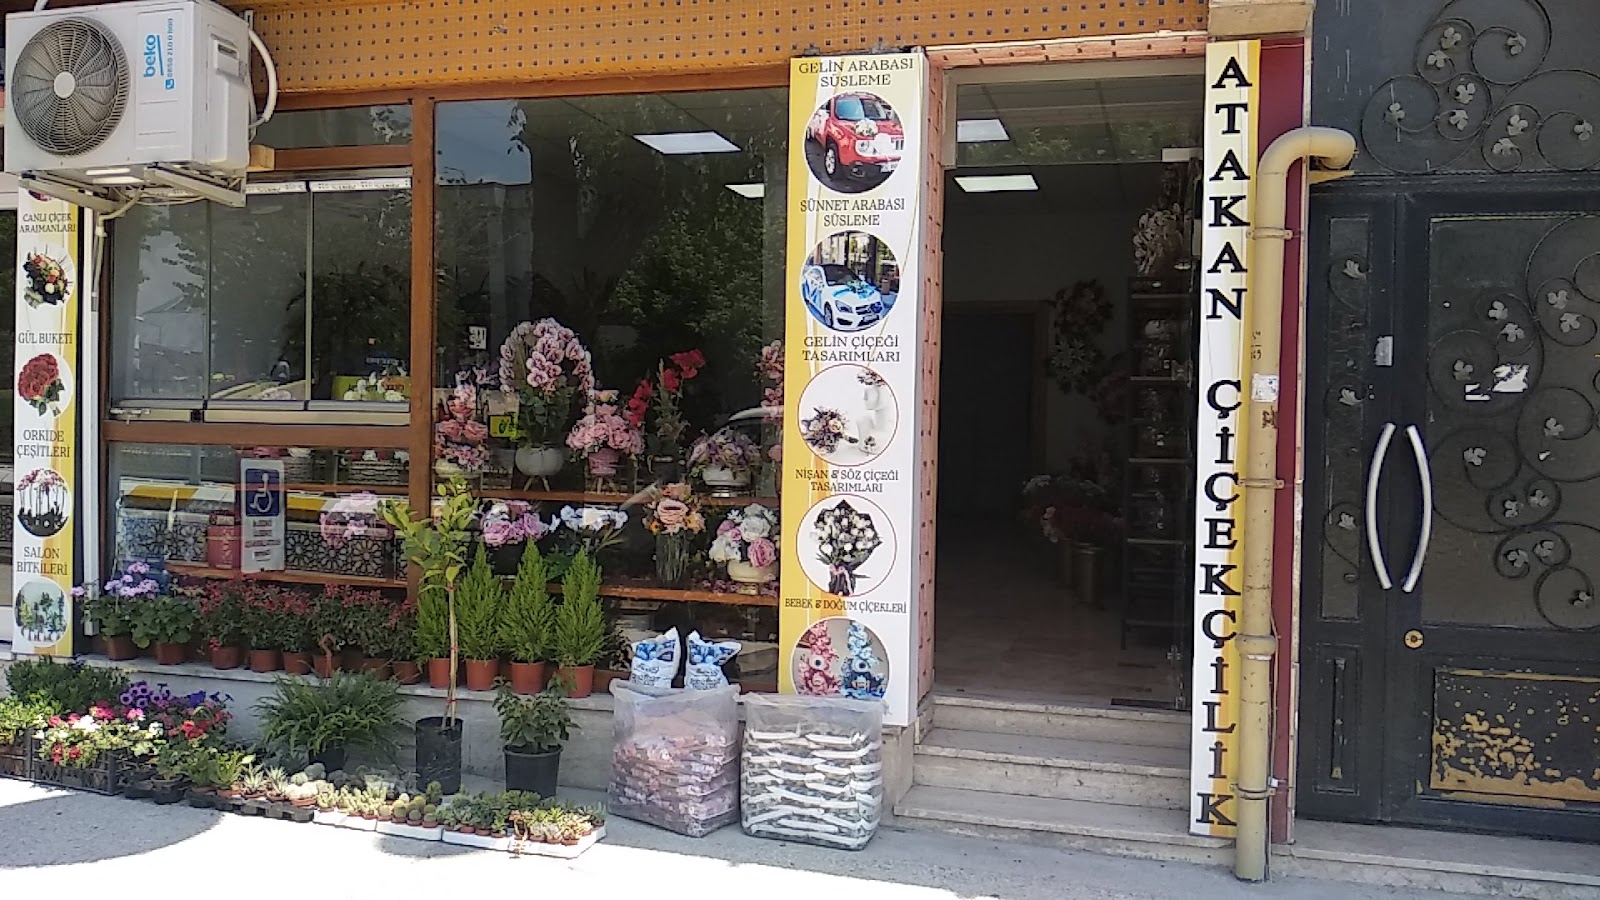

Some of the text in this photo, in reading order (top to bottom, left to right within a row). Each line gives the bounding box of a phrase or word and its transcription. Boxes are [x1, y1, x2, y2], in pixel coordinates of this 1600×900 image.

[143, 34, 156, 78] beko
[798, 58, 914, 74] GELİN ARABASI
[820, 73, 891, 87] SÜSLEME
[800, 198, 905, 212] SÜNNET ARABASI
[22, 211, 72, 224] CANLI ÇİÇEK
[823, 214, 880, 227] SÜSLEME
[18, 329, 73, 345] GÜL BUKETİ
[803, 335, 899, 350] GELİN ÇİÇEĞİ
[802, 350, 900, 363] TASARIMLARI
[1196, 56, 1253, 827] ATAKAN ÇİÇEKÇİLİK
[16, 443, 70, 459] ÇEŞİTLERİ
[795, 467, 829, 481] NİŞAN
[840, 468, 862, 481] SÖZ
[863, 469, 899, 482] ÇİÇEĞİ
[811, 481, 883, 493] TASARIMLARI
[23, 546, 60, 559] SALON
[16, 559, 68, 576] BİTKİLERİ
[785, 598, 813, 609] BEBEK
[823, 599, 858, 611] DOĞUM
[858, 600, 907, 614] ÇİÇEKLERİ
